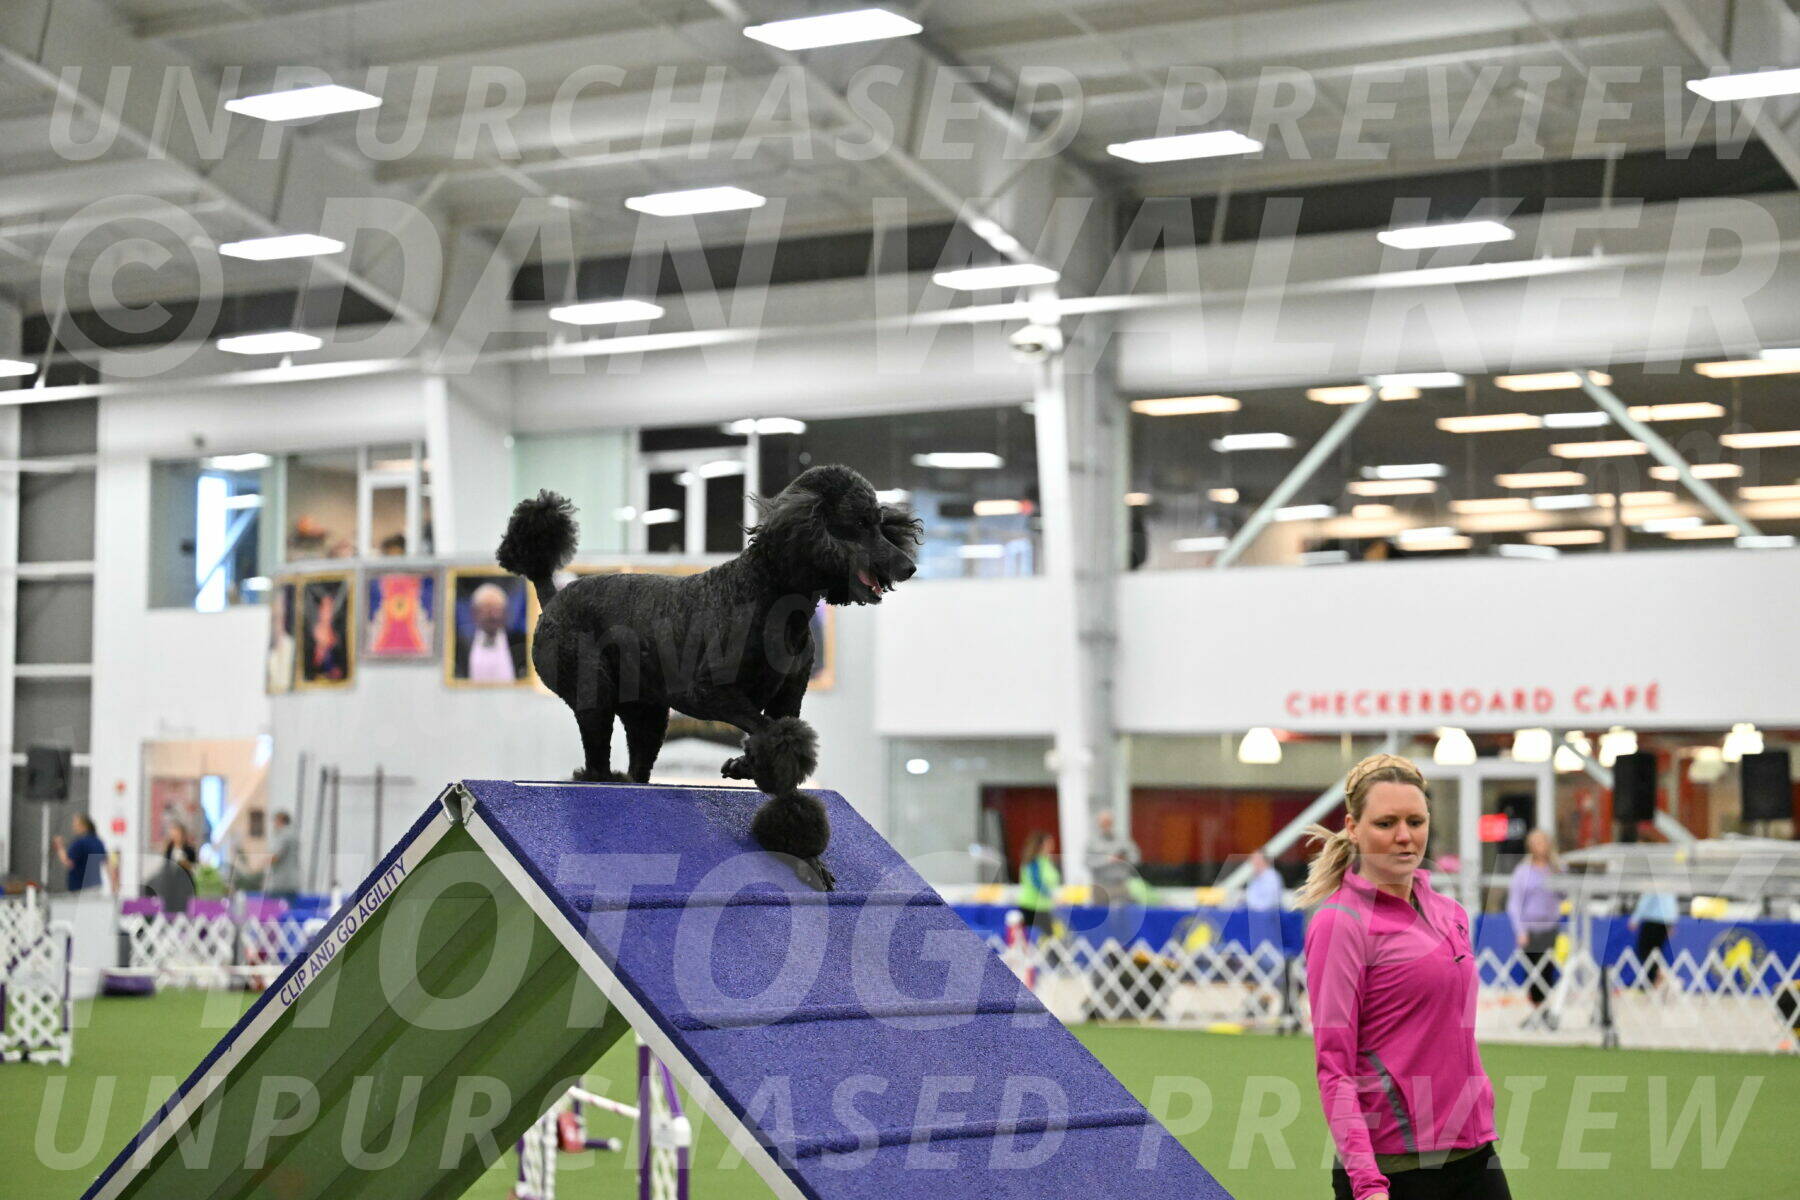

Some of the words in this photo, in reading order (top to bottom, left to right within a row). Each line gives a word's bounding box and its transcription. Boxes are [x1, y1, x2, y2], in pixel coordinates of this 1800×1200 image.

[1286, 686, 1555, 717] CHECKERBOARD
[1573, 681, 1660, 714] CAFÉ
[280, 969, 307, 1007] CLIP
[309, 940, 336, 978] AND
[336, 915, 357, 943] GO
[359, 857, 407, 923] AGILITY
